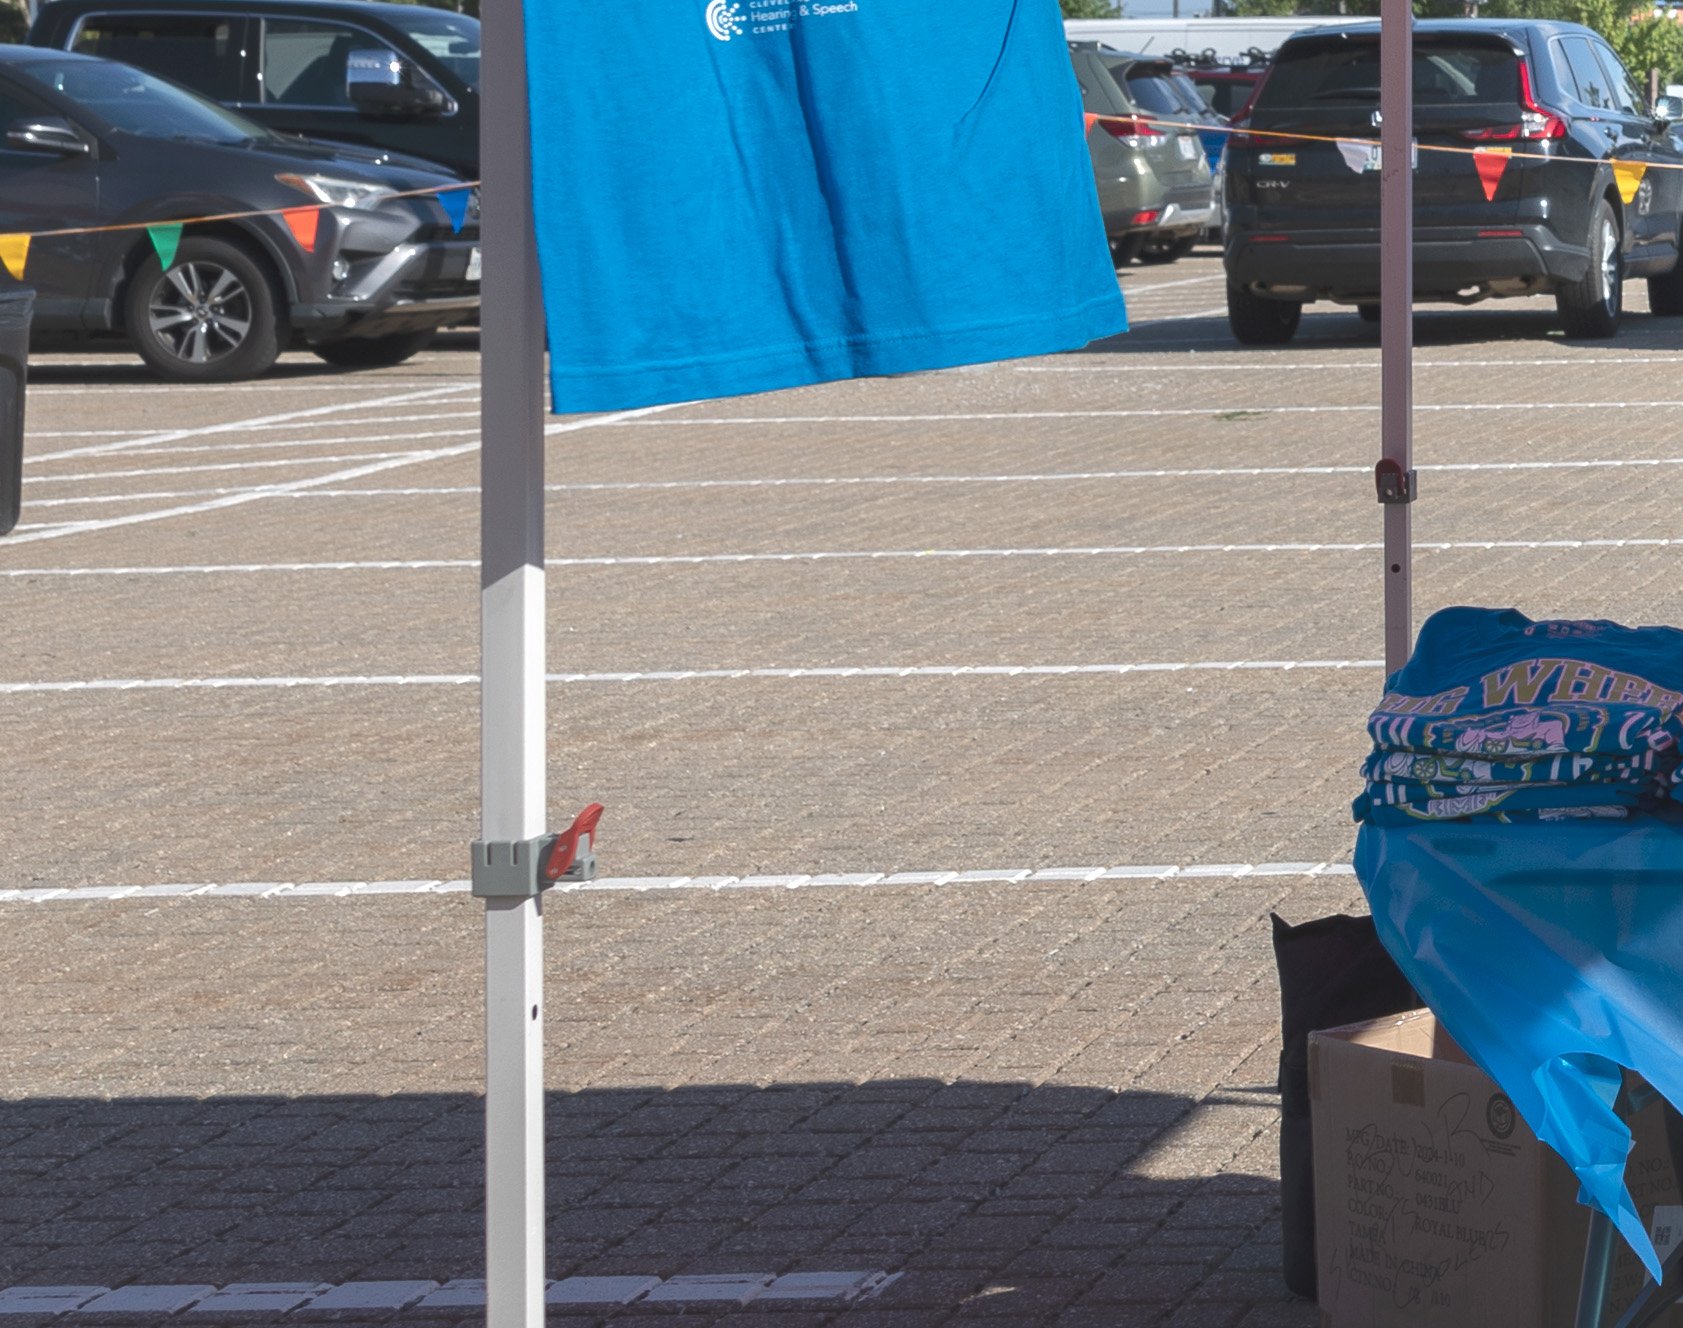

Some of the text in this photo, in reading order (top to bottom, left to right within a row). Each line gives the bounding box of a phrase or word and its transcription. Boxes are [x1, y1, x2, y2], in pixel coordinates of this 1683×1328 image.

[799, 5, 810, 17] &
[812, 0, 859, 16] Speech
[1256, 180, 1291, 189] CR-V
[1347, 1174, 1373, 1195] PART
[1414, 1215, 1487, 1247] ROYAL BLUE
[1349, 1243, 1382, 1266] MADE
[1385, 1251, 1399, 1270] IN
